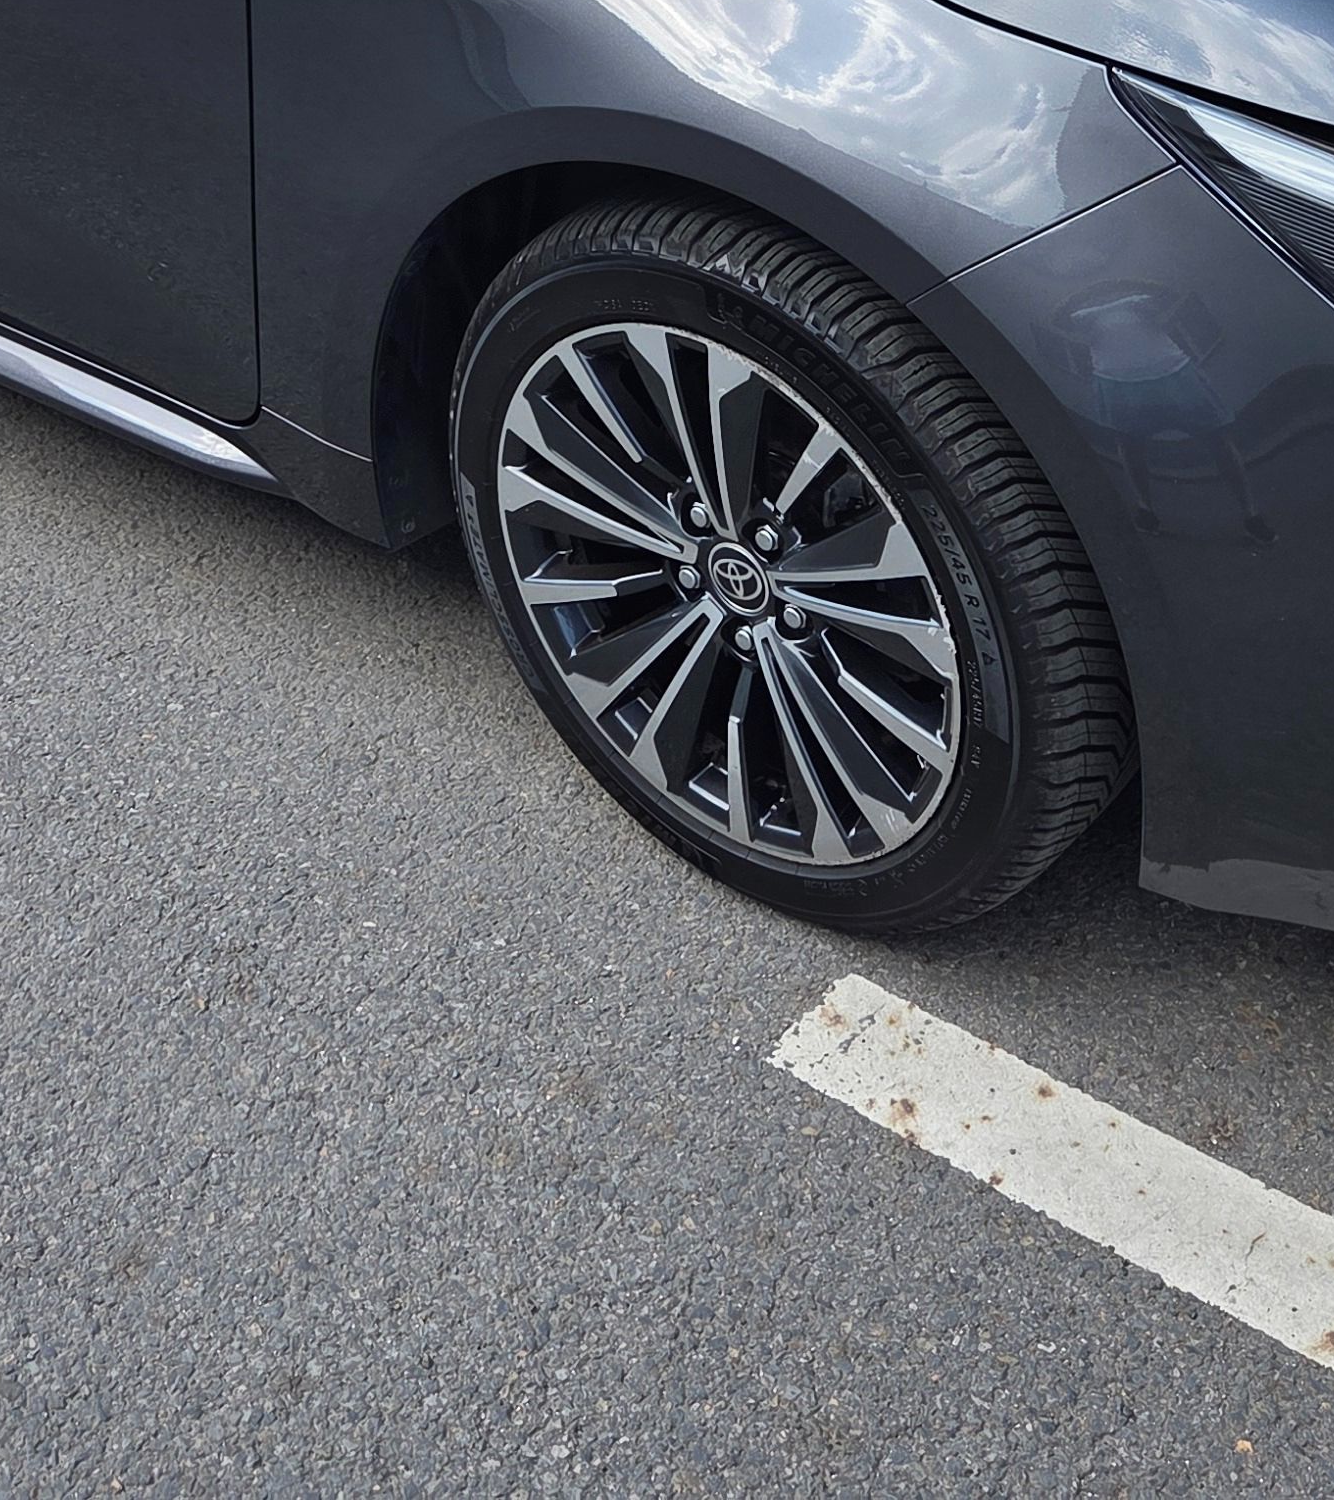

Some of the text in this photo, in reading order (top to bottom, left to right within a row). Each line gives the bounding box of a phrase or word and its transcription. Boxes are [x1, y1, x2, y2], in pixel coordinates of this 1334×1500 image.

[748, 312, 910, 466] MICHELIN
[920, 503, 991, 640] 225/45 R 17
